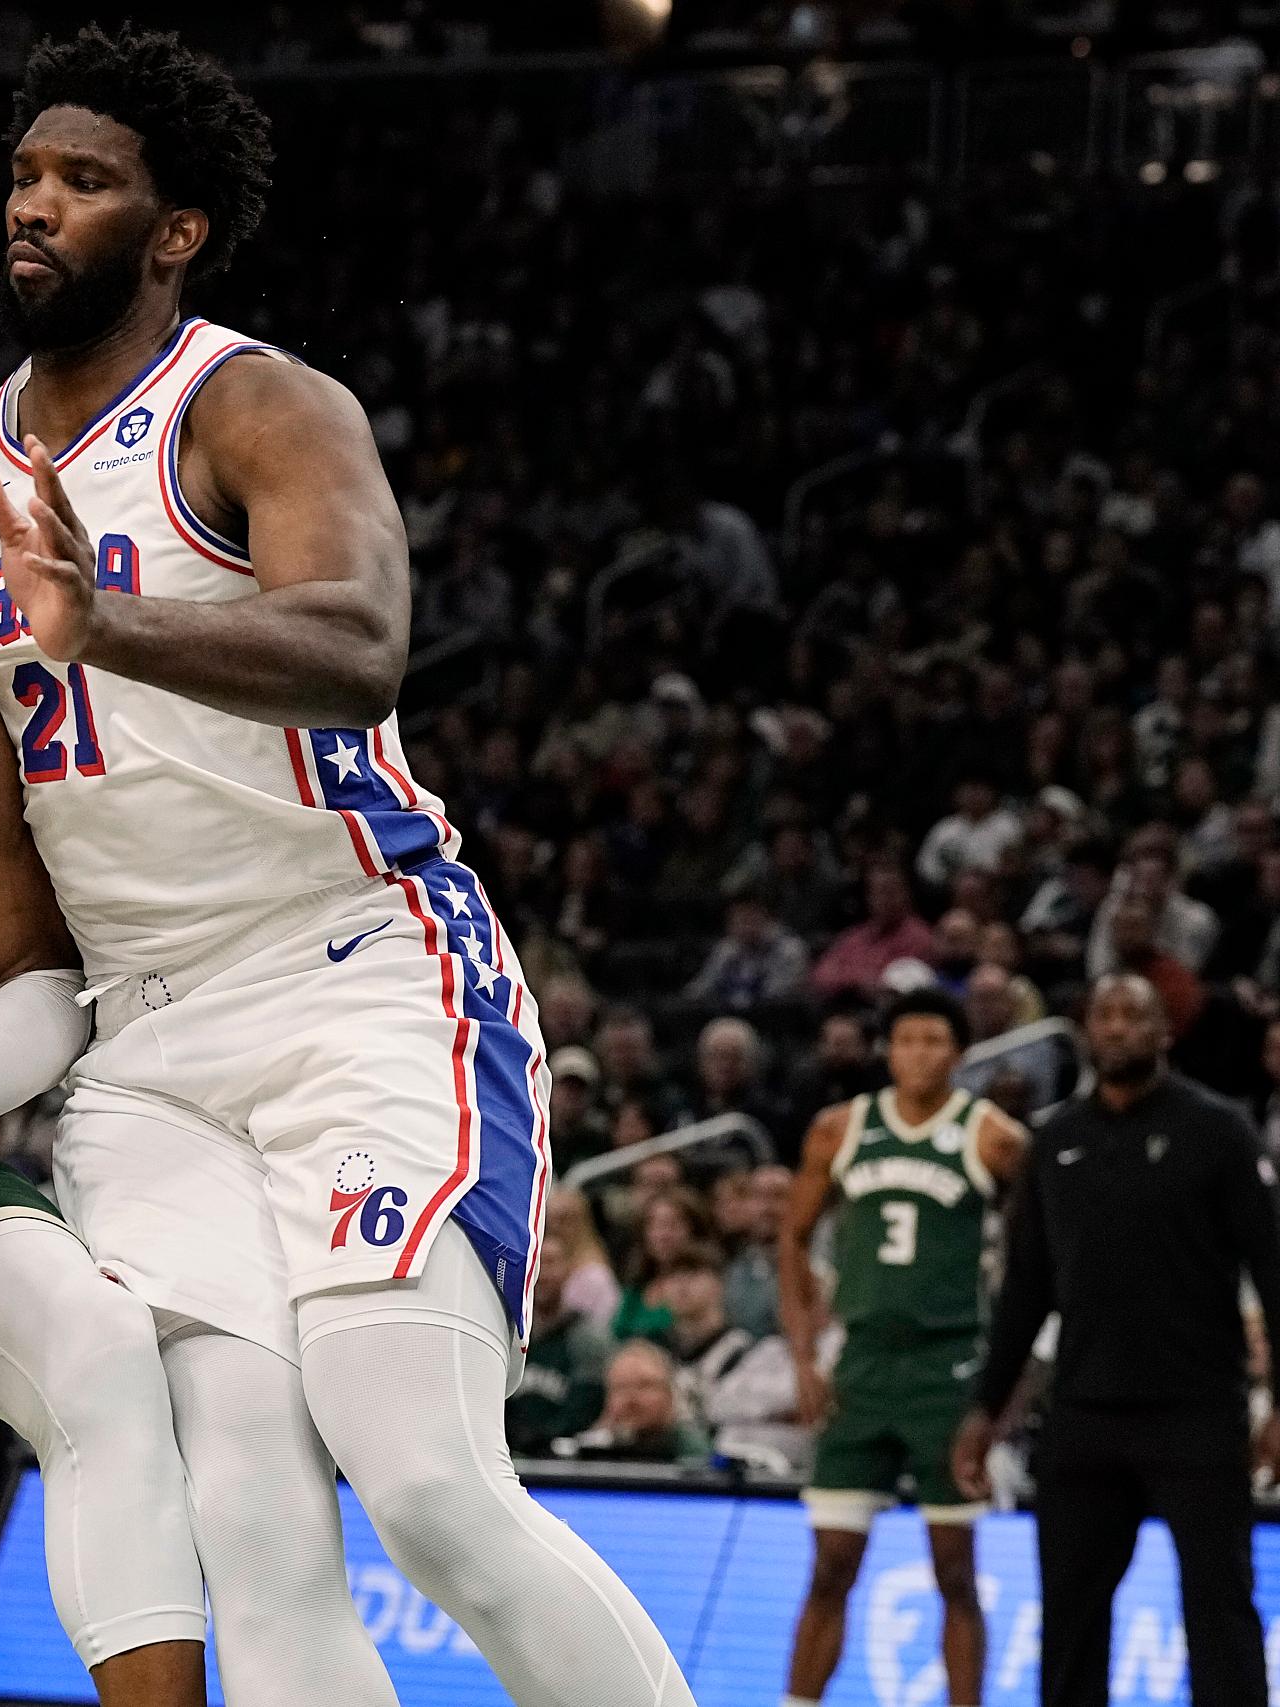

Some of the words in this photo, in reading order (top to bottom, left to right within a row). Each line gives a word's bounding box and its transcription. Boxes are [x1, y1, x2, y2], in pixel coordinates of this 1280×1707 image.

[93, 450, 154, 471] crypto.com
[12, 661, 107, 784] 21
[329, 1184, 408, 1252] 76
[877, 1200, 918, 1266] 3
